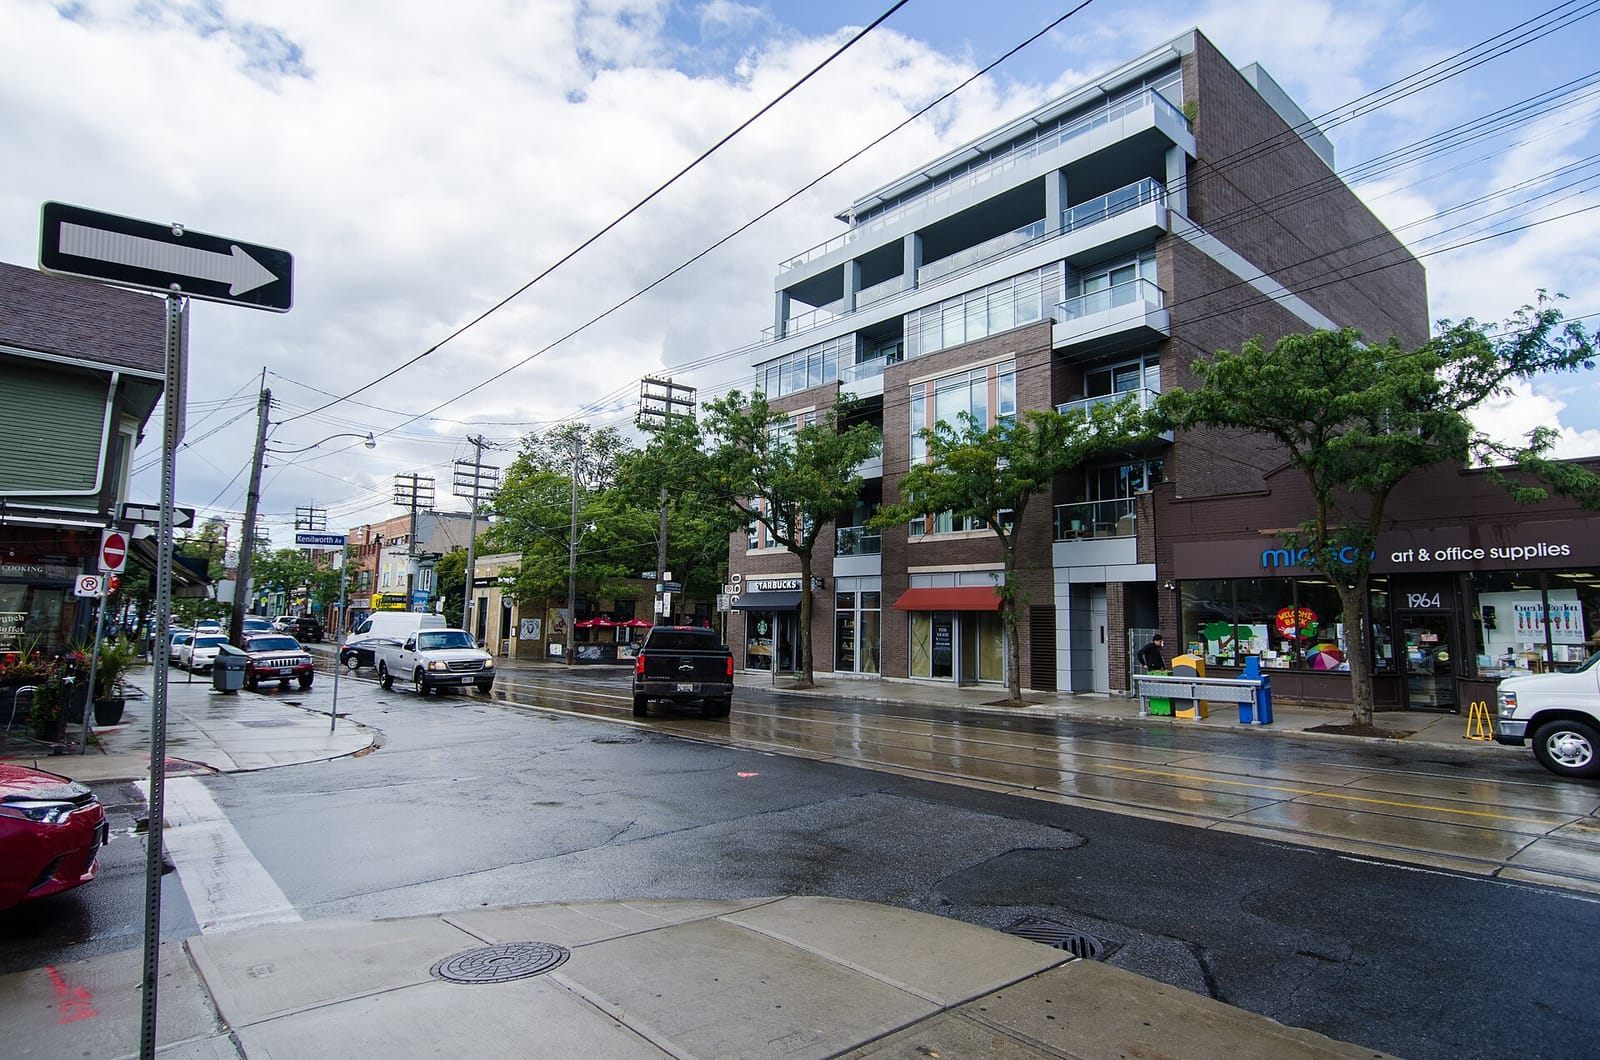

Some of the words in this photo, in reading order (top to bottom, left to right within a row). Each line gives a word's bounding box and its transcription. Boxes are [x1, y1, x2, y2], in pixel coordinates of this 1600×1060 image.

[1391, 549, 1414, 563] art
[1418, 548, 1431, 562] &
[1434, 547, 1485, 561] office
[1490, 543, 1571, 561] supplies
[754, 580, 797, 590] STARBUCKS
[1406, 593, 1441, 608] 1964
[0, 614, 25, 623] unch
